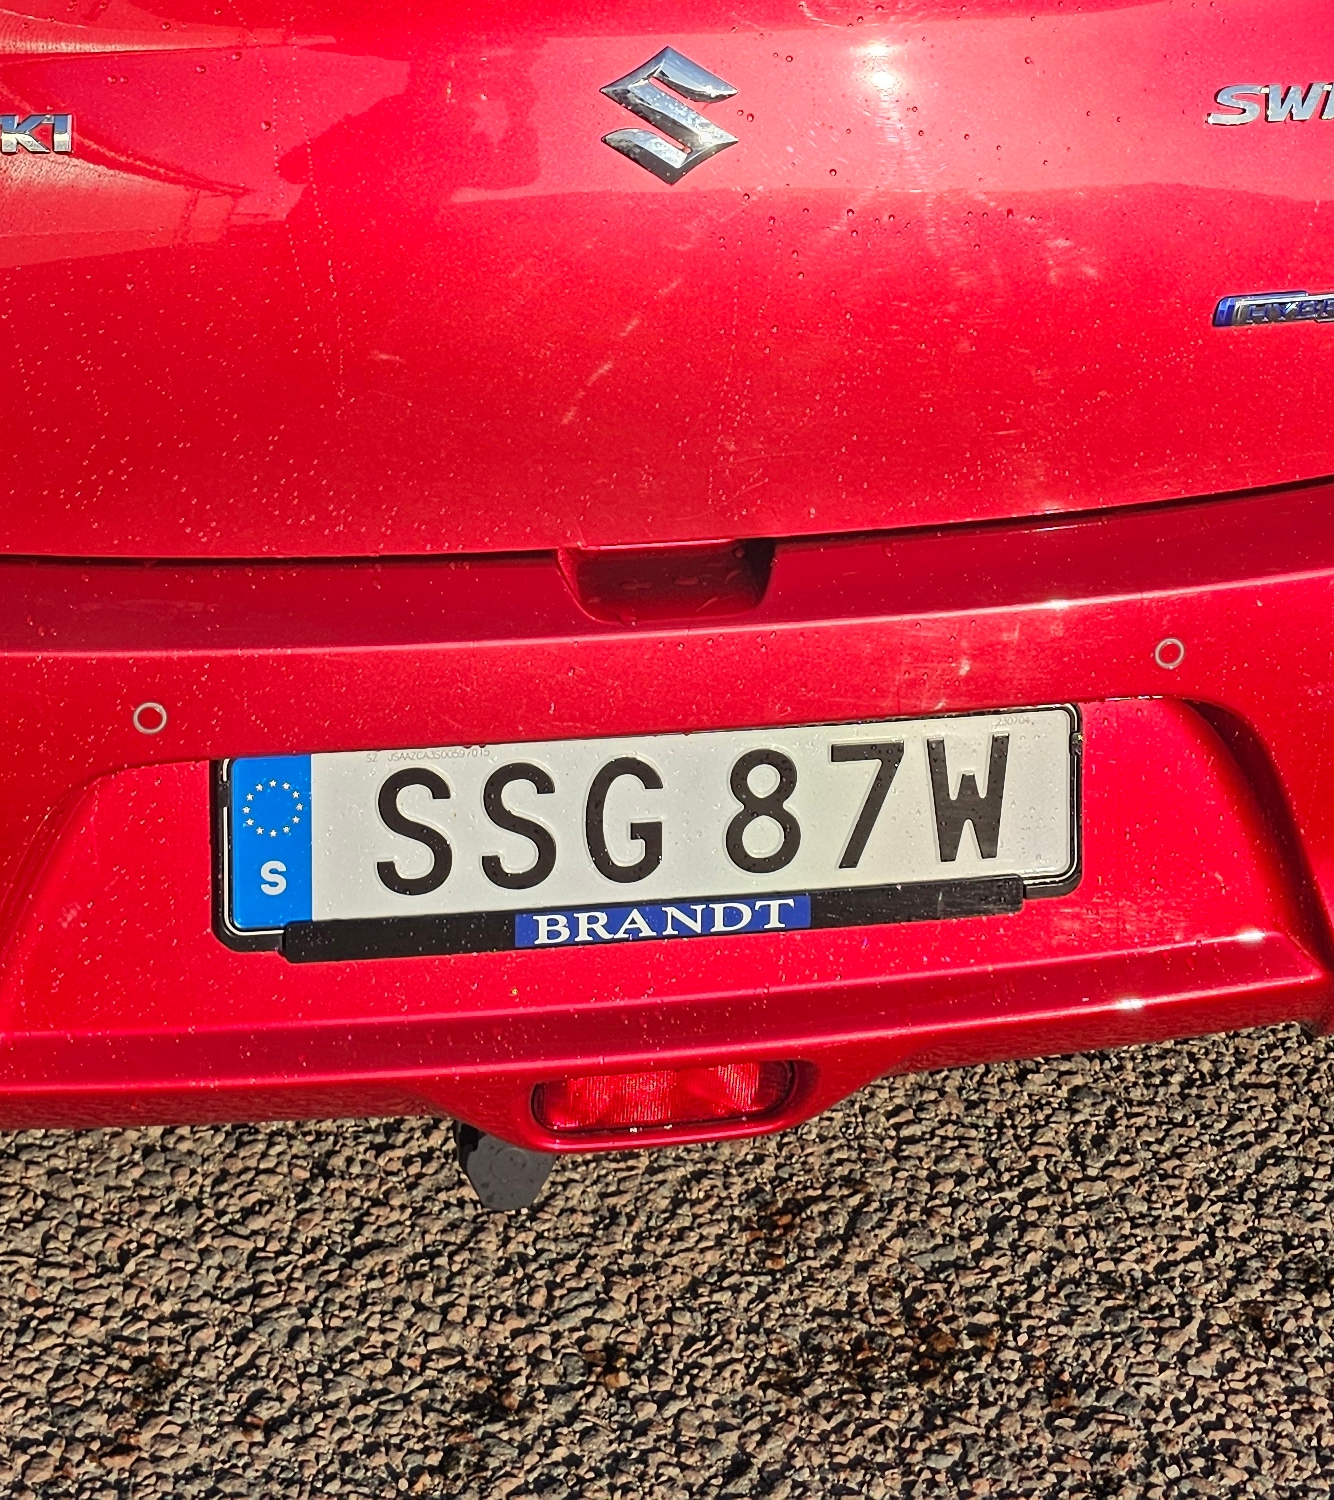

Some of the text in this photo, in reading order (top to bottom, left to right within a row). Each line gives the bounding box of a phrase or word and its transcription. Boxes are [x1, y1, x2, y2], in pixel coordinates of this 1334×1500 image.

[377, 733, 1010, 896] SSG 87W
[260, 860, 287, 896] S
[533, 899, 794, 945] BRANDT
